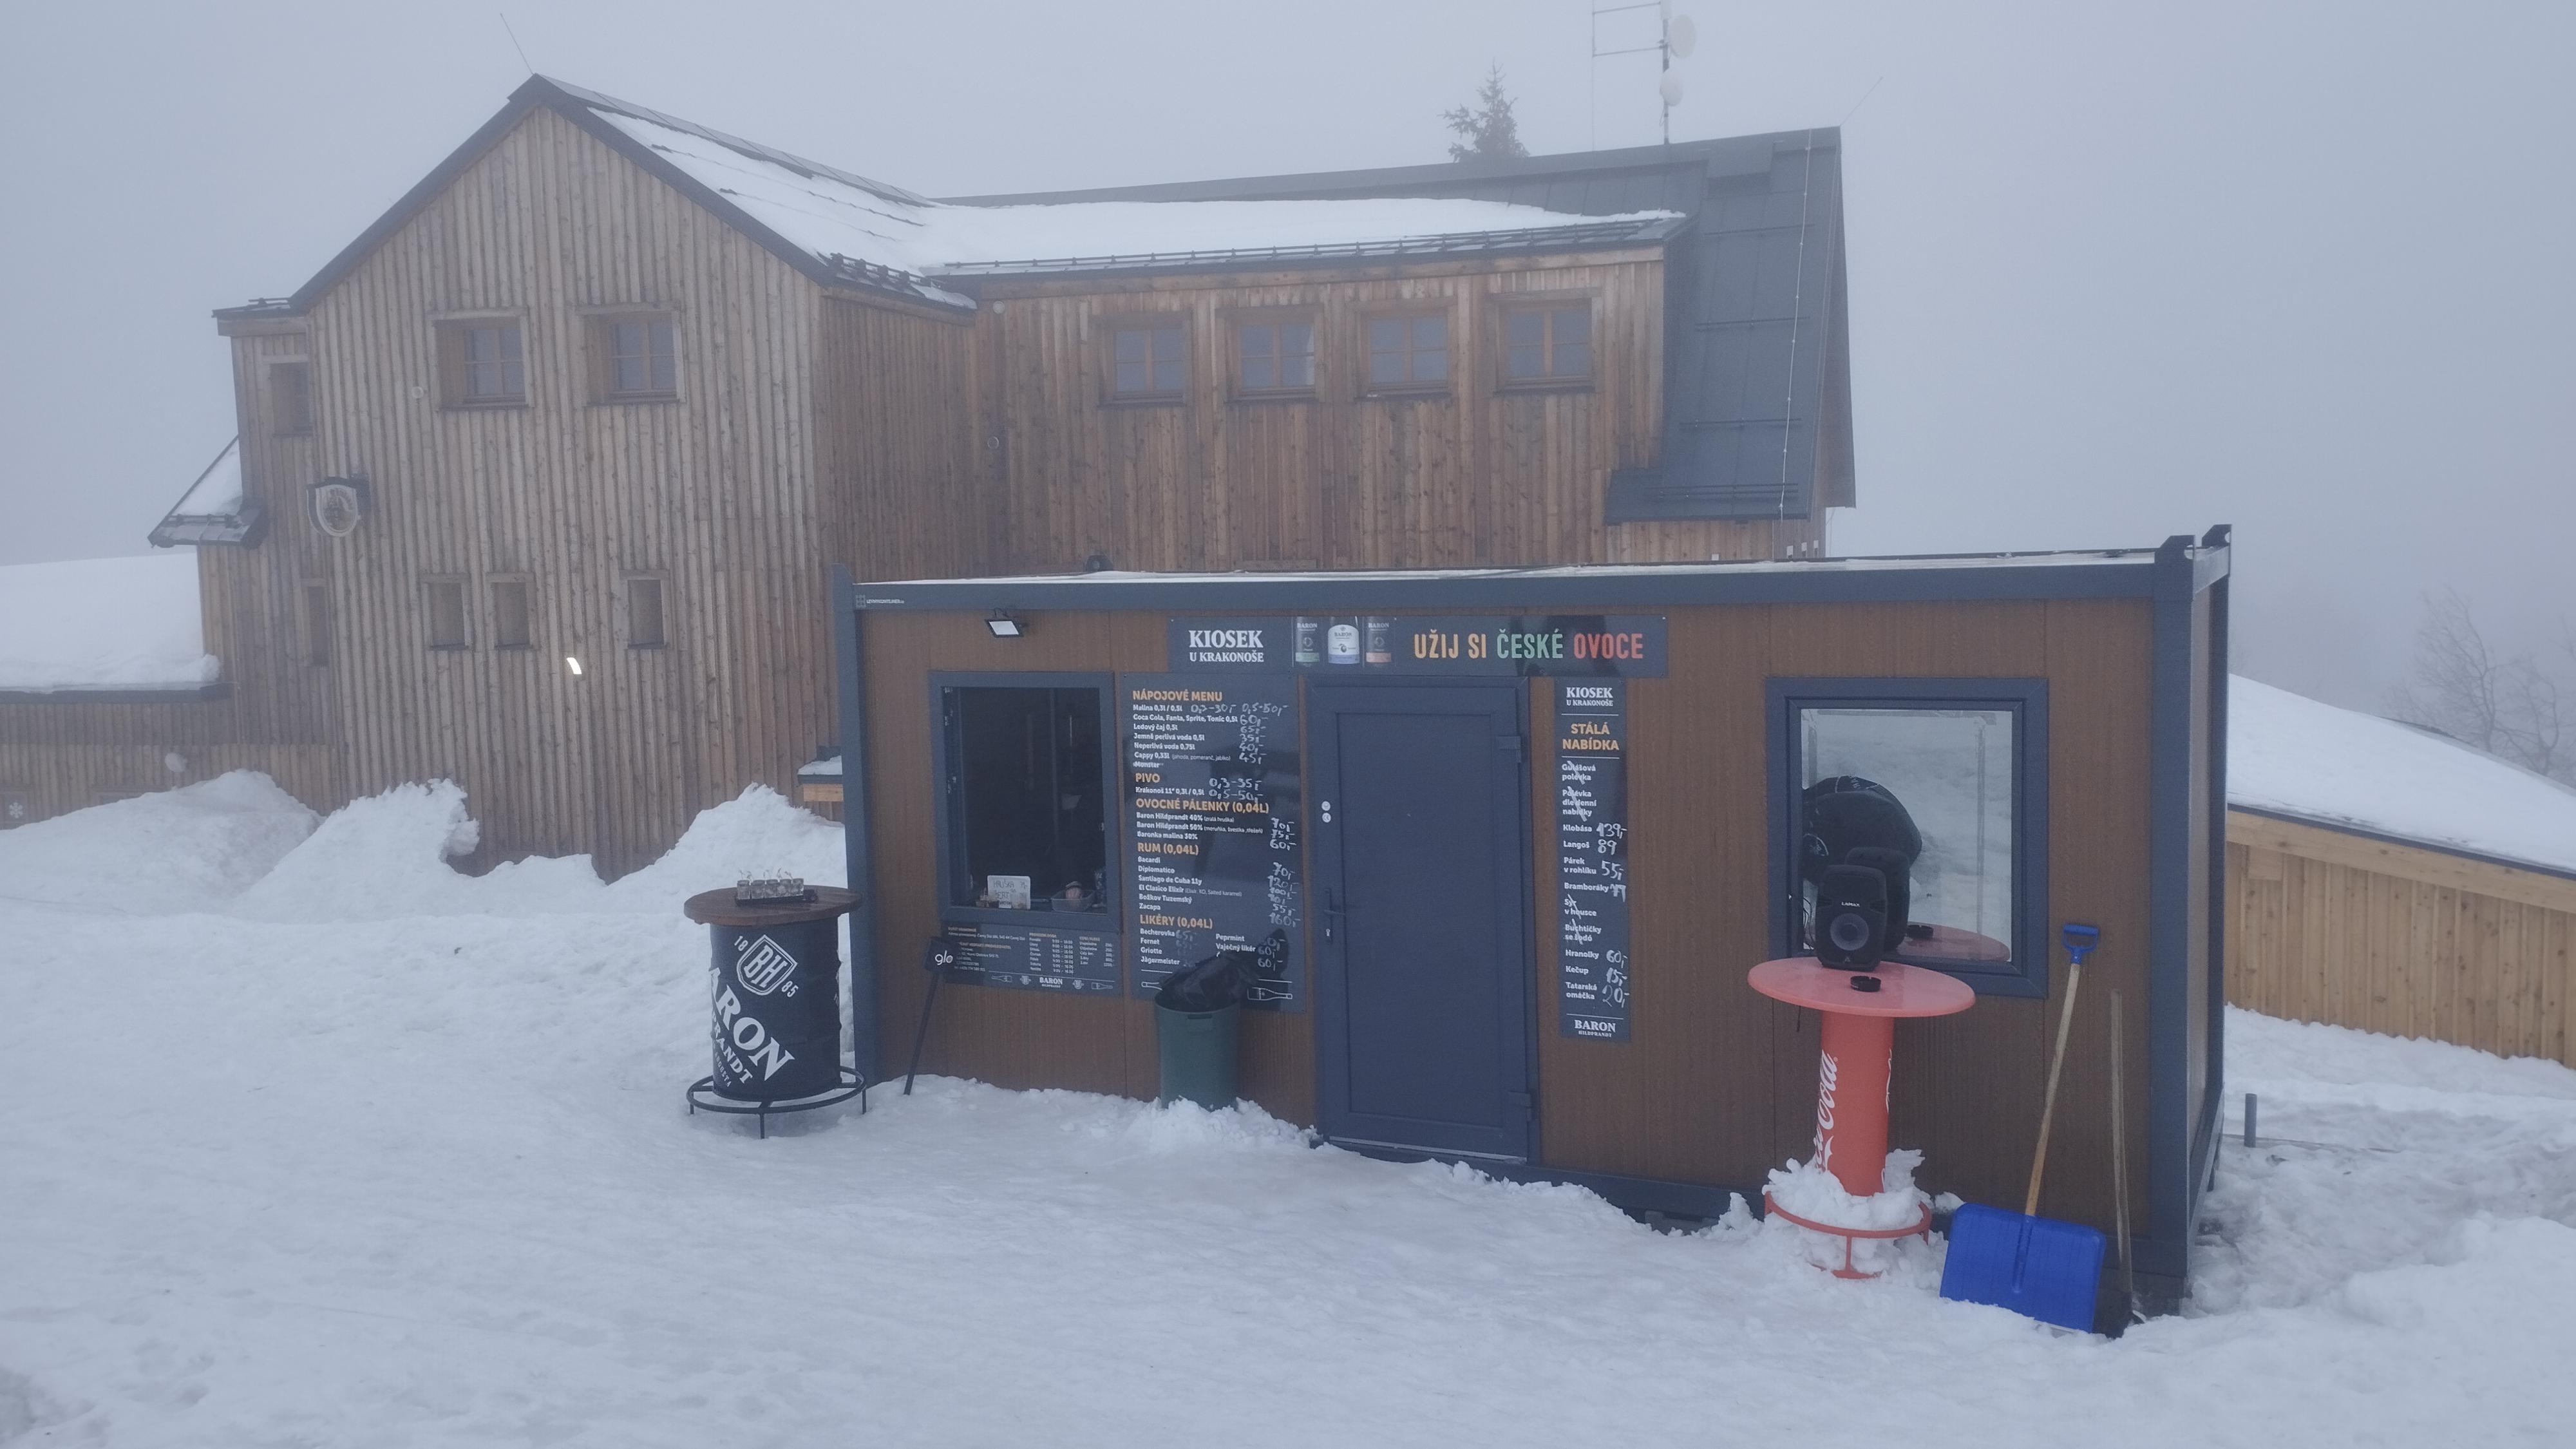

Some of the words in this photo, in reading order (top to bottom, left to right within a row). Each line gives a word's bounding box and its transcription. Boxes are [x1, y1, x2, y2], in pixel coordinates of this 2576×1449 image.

[1188, 630, 1264, 648] KIOSEK
[1414, 629, 1459, 659] UŽIJ
[1468, 634, 1486, 659] SI
[1497, 628, 1564, 659] ČESKÉ
[1573, 633, 1643, 659] OVOCE
[1189, 652, 1197, 662] U
[1199, 649, 1264, 662] KRAKONOŠE
[1133, 688, 1189, 701] NÁPOJOVÉ
[1191, 691, 1222, 701] MENU
[1566, 687, 1613, 699] KIOSEK
[1150, 714, 1166, 722] Cola,
[1571, 721, 1610, 734] STÁLÁ
[1134, 742, 1163, 750] Neperlivá
[1562, 737, 1620, 750] NABÍDKA
[1134, 752, 1153, 760] Cappy
[1135, 773, 1160, 783] PIVO
[1136, 798, 1180, 810] OVOCNÉ
[1183, 799, 1230, 811] PÁLENKY
[1155, 813, 1188, 821] Hildprandt
[1155, 822, 1189, 831] Hildprandt
[1137, 842, 1161, 853] RUM
[1563, 840, 1590, 849] Langoš
[1598, 839, 1617, 855] 89
[1138, 866, 1175, 874] Diplomatico
[1139, 875, 1164, 884] Santiago
[1564, 882, 1609, 893] Bramboráky
[1162, 895, 1192, 904] Tuzemský
[1140, 913, 1175, 926] LIKÉRY
[1140, 928, 1175, 937] Becherovka
[1215, 933, 1245, 942] Peprmint
[734, 936, 748, 951] 18
[1216, 943, 1240, 952] Vaječný
[934, 950, 953, 965] glo
[1566, 949, 1600, 959] Hranolky
[1141, 956, 1180, 965] Jägermeister
[1566, 965, 1589, 974] Kečup
[781, 981, 799, 998] 85
[1566, 981, 1597, 990] Tatarská
[1574, 1019, 1616, 1033] BARON
